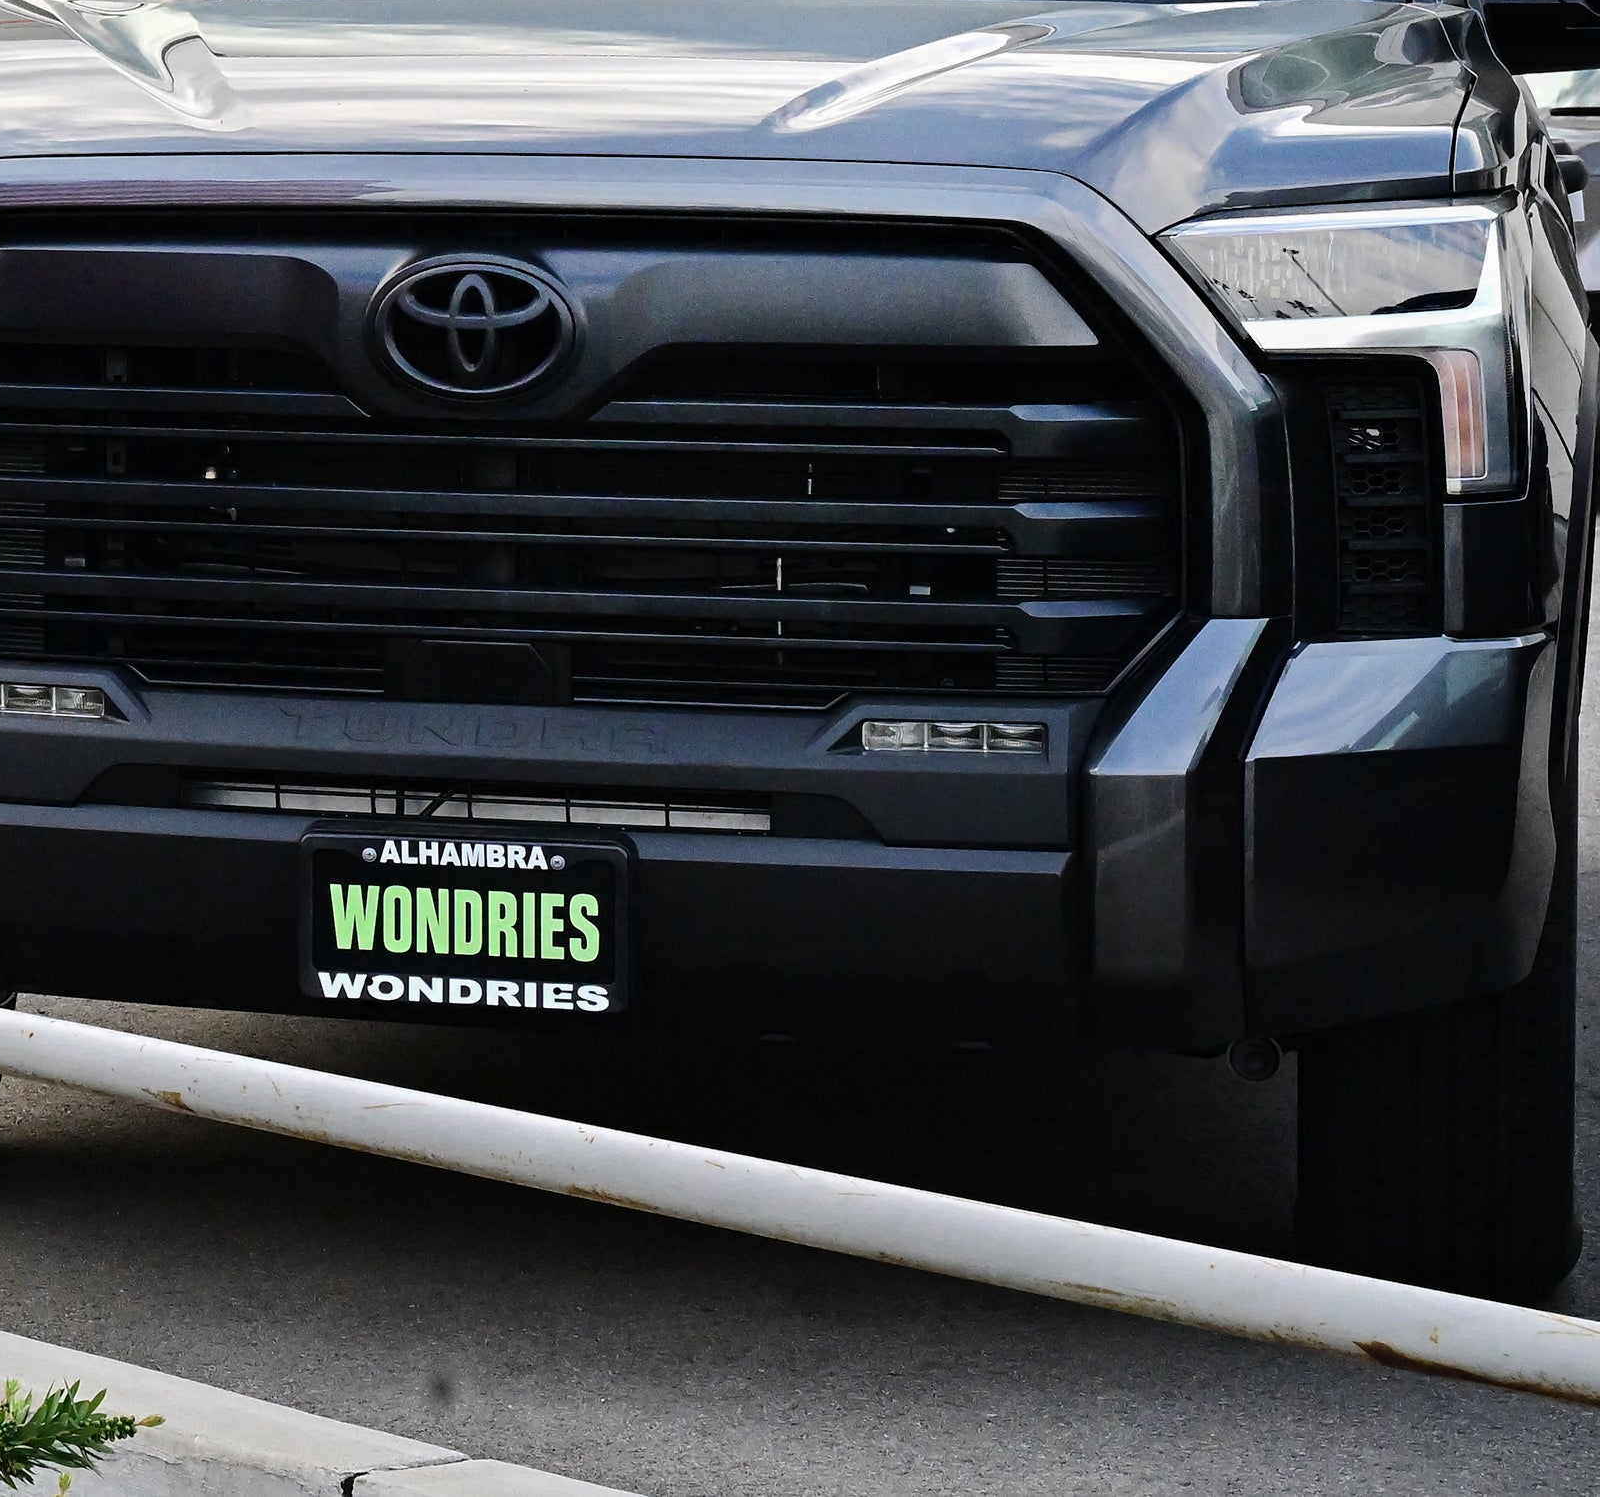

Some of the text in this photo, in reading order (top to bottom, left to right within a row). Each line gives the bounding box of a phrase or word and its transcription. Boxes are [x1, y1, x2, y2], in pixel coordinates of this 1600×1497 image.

[380, 840, 548, 870] ALHAMBRA
[329, 883, 600, 962] WONDRIES
[318, 971, 610, 1012] WONDRIES
